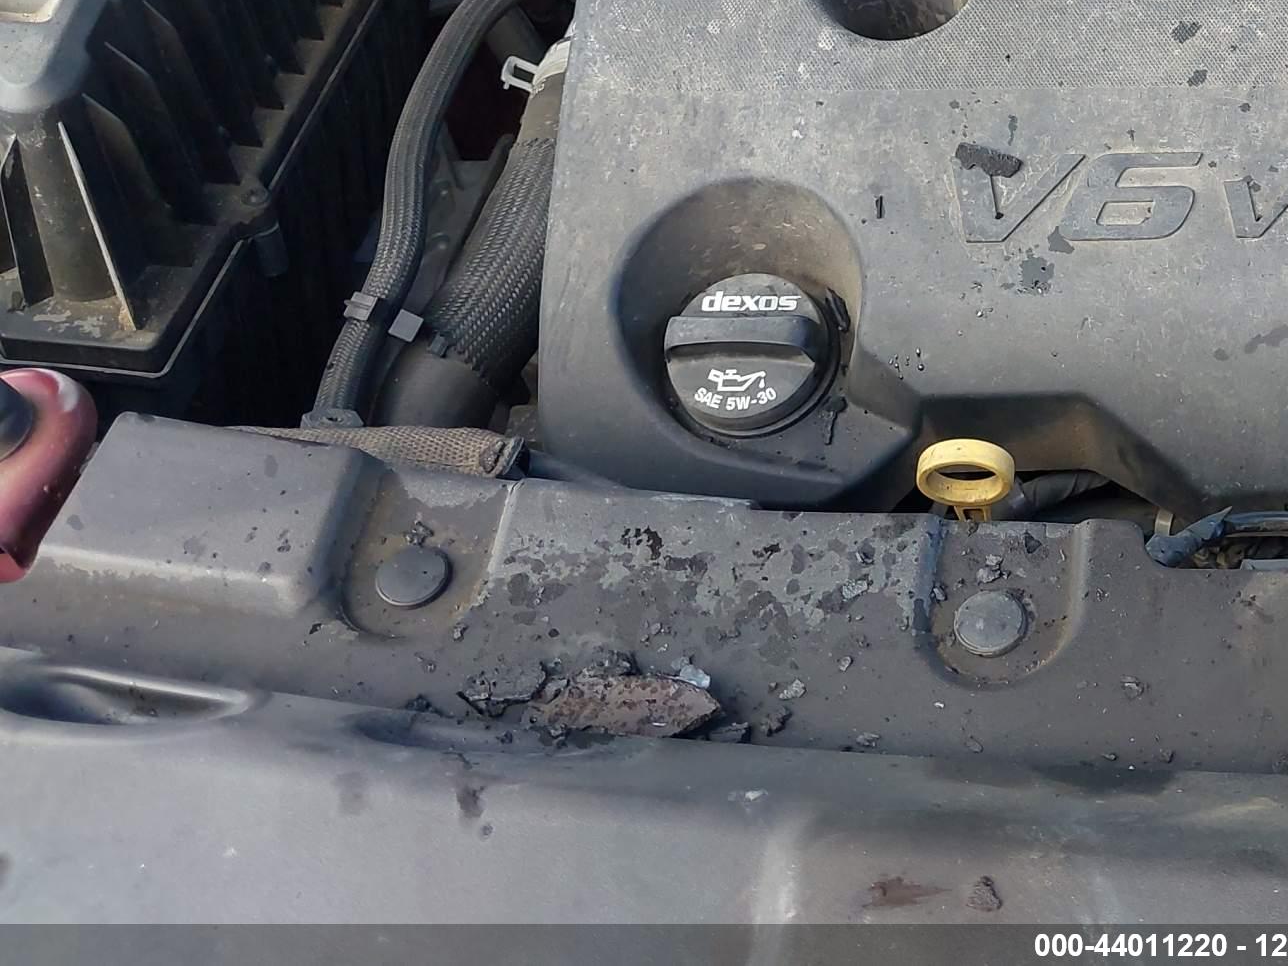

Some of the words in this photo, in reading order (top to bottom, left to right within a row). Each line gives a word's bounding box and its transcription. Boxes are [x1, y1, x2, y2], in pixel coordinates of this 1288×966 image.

[953, 151, 1203, 243] V6
[702, 291, 802, 312] dexos
[694, 388, 723, 409] SAE
[726, 388, 777, 411] 5W-30
